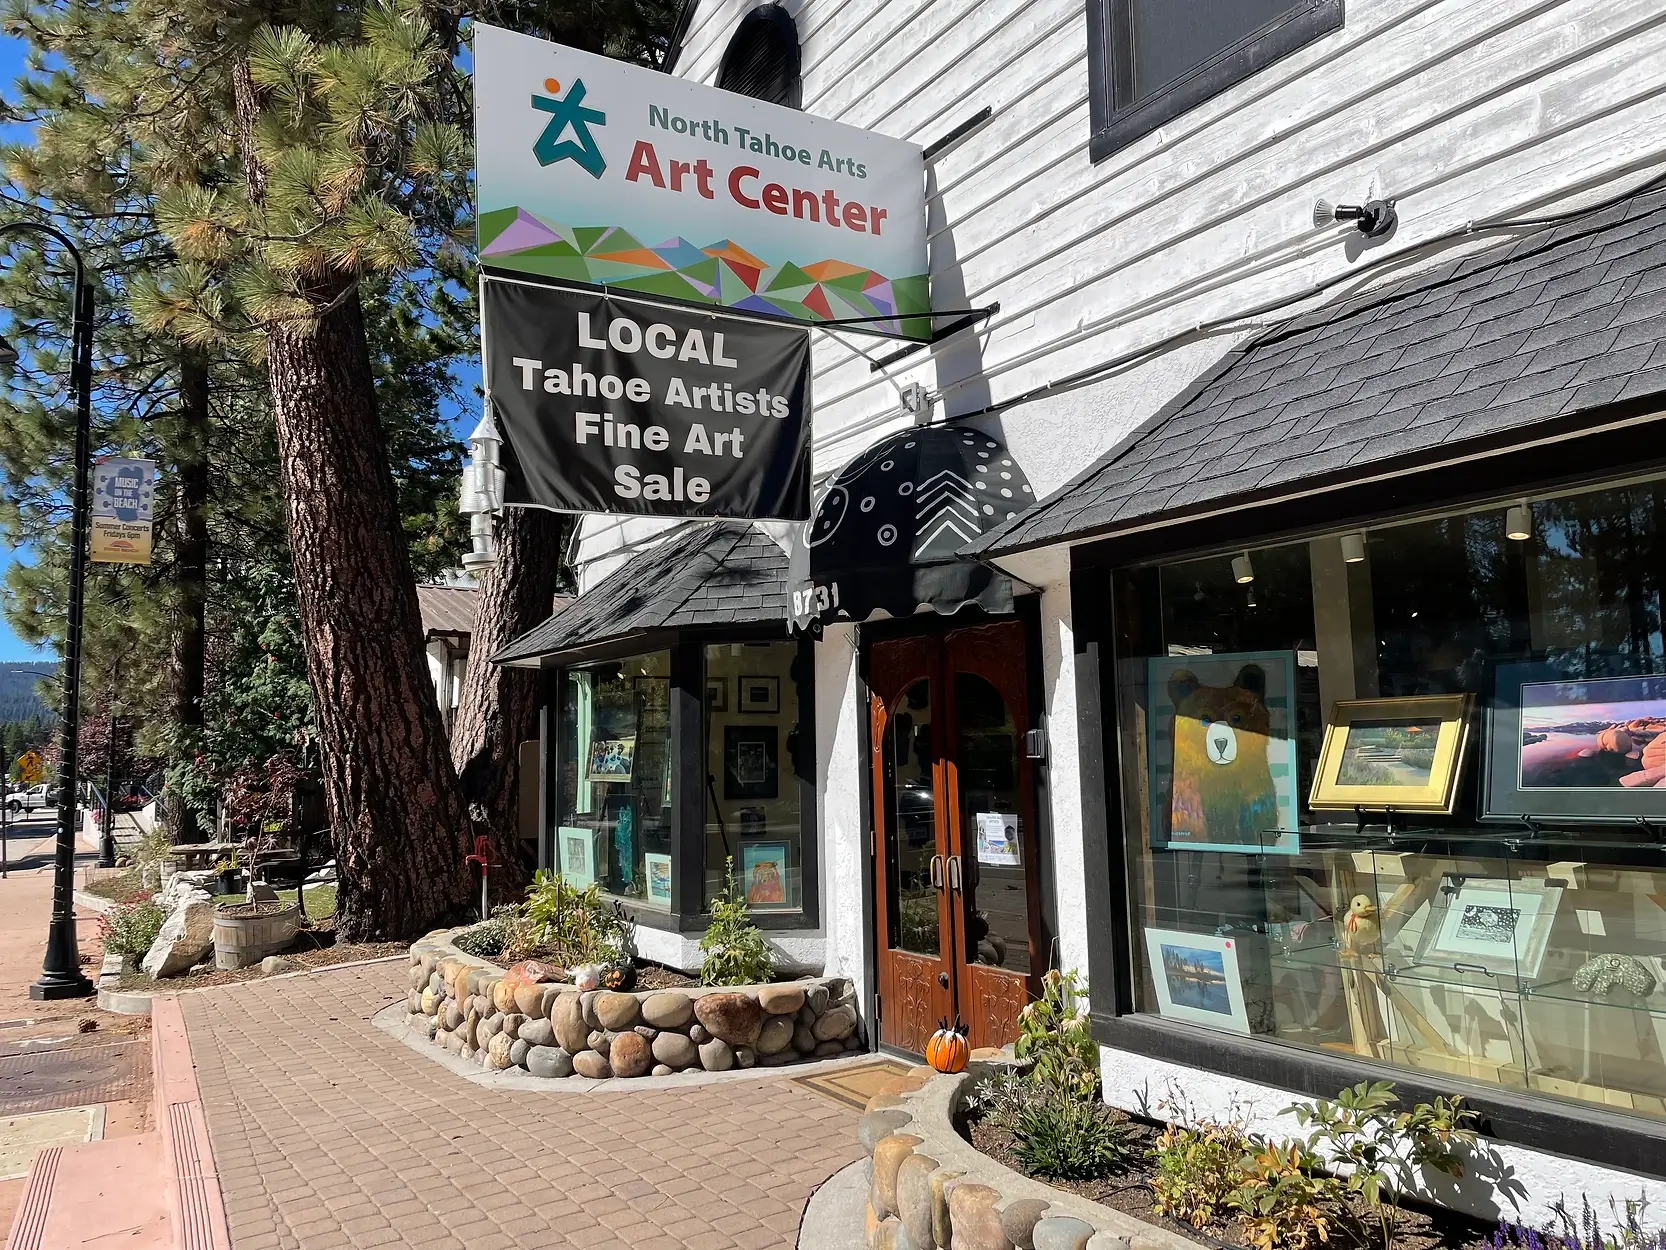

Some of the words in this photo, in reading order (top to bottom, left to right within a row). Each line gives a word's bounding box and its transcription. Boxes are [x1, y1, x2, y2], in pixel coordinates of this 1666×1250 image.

[649, 103, 729, 146] North
[733, 125, 811, 166] Tahoe
[817, 148, 868, 180] Arts
[625, 139, 715, 200] Art
[727, 165, 889, 237] Center
[577, 311, 738, 369] LOCAL
[512, 356, 651, 403] Tahoe
[664, 376, 790, 420] Artists
[575, 411, 670, 452] Fine
[683, 422, 745, 459] Art
[115, 477, 138, 488] MUSIC
[123, 489, 134, 497] THE
[613, 463, 711, 504] Sale
[113, 498, 138, 509] BEACH
[95, 521, 121, 530] Summer
[103, 529, 126, 540] Fridays
[127, 531, 140, 540] 6pm
[792, 581, 840, 617] 8731
